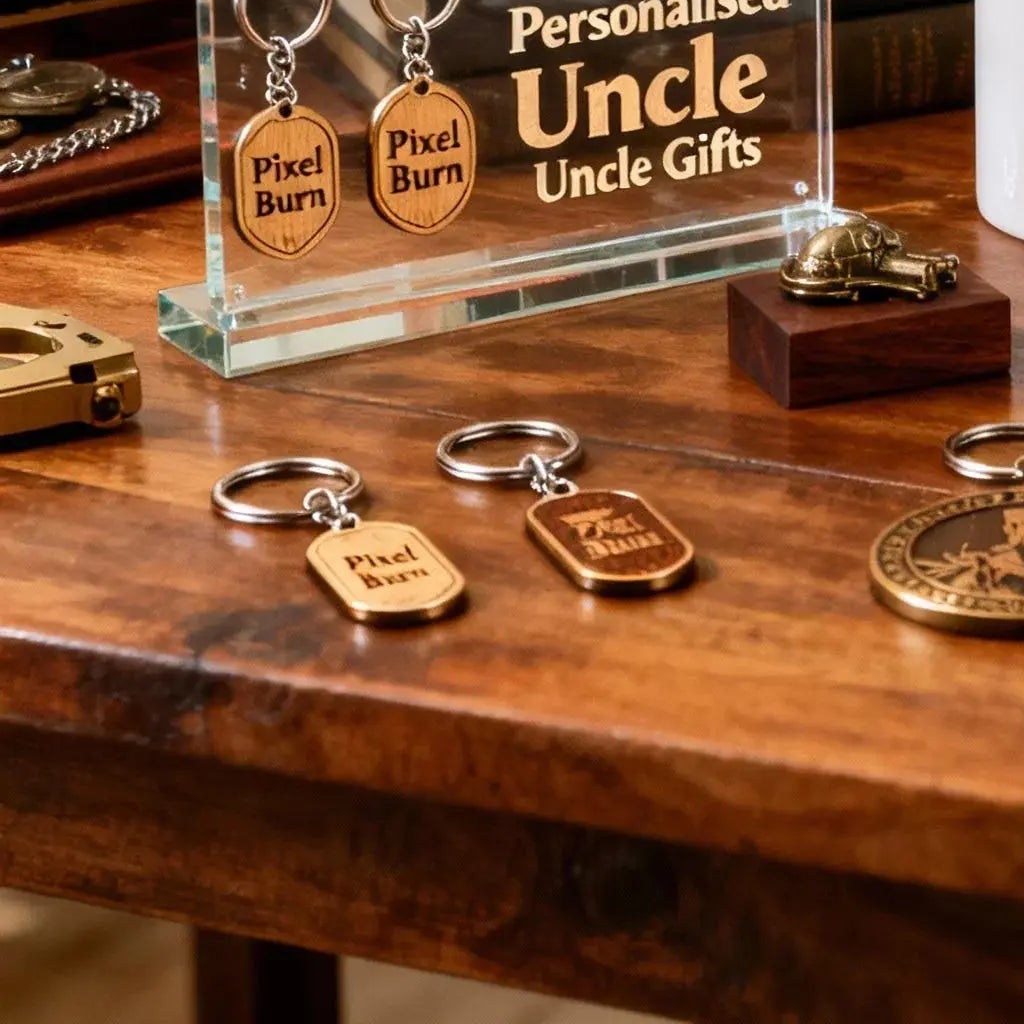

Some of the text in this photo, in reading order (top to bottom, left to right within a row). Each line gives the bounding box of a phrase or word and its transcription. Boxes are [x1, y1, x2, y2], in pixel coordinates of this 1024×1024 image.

[511, 31, 768, 149] Uncle
[386, 118, 461, 160] Pixel
[251, 144, 323, 184] Pixel
[387, 161, 464, 195] Burn
[533, 125, 762, 203] Uncle Gifts
[255, 187, 327, 218] Burn
